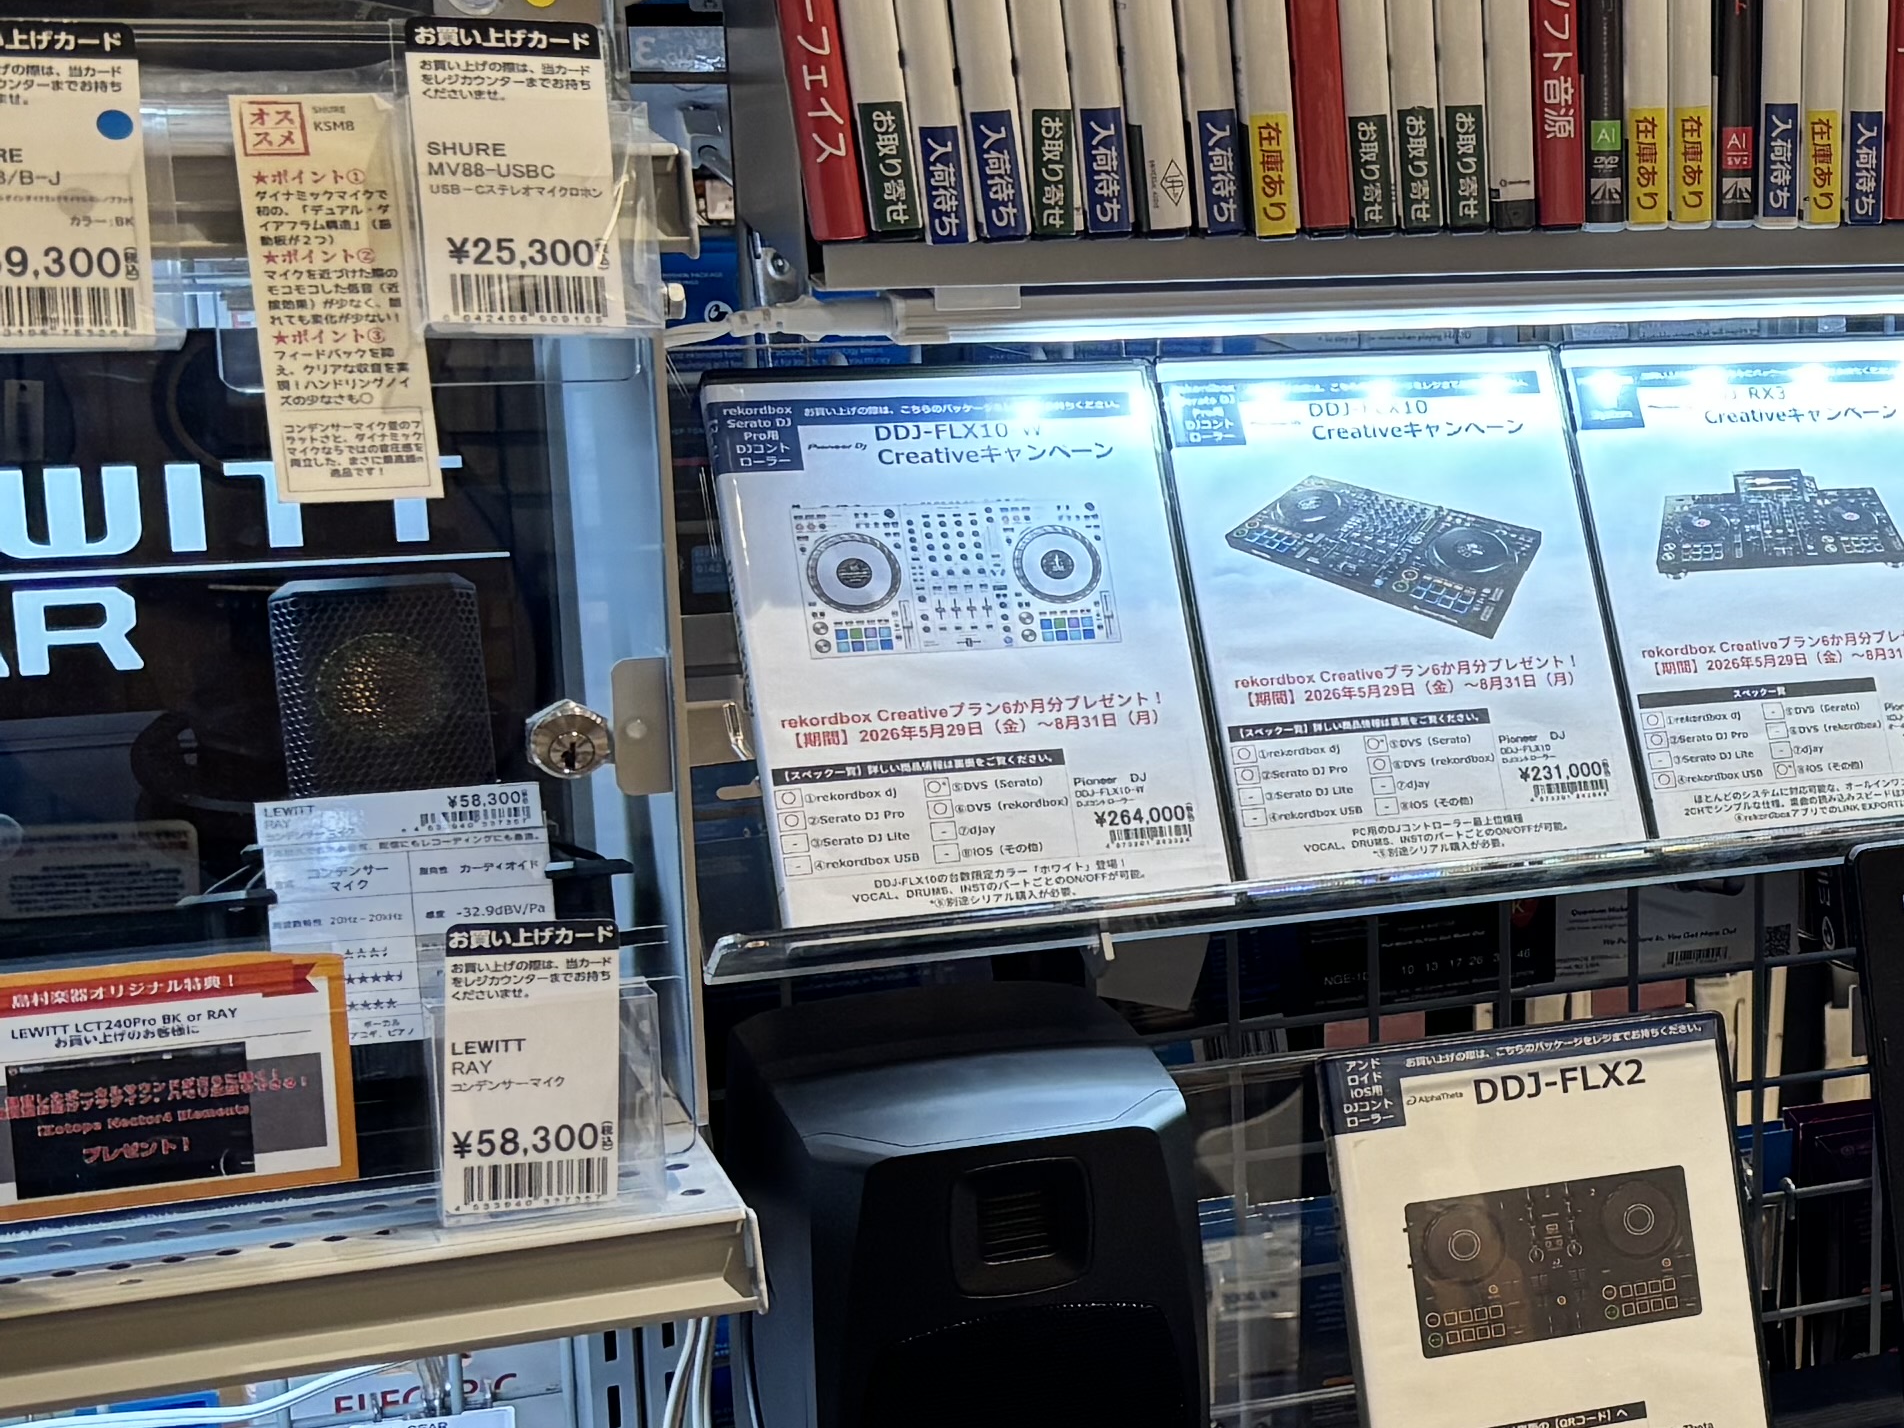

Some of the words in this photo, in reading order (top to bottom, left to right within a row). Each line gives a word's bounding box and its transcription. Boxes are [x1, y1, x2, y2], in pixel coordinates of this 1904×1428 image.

[414, 27, 590, 50] お買い上げカード
[426, 141, 506, 158] SHURE
[428, 162, 555, 180] MV88-USBC
[870, 111, 909, 224] お取り寄せ
[1258, 122, 1288, 221] 在庫あり
[255, 189, 387, 202] ダイナミックマイクで
[927, 138, 959, 236] 入荷待ち
[1704, 405, 1898, 426] Creativeキャンペーン
[877, 441, 1115, 466] Creativeキャンペーン
[1234, 673, 1315, 689] rekordbox
[780, 712, 871, 730] rekordbox
[1520, 762, 1602, 781] ¥231,000
[1094, 808, 1184, 828] ¥264,000
[448, 923, 614, 948] お買い上げカード
[451, 1038, 526, 1056] LEWITT
[451, 1060, 492, 1075] RAY
[451, 1075, 564, 1093] コンデンサーマイク
[1418, 1091, 1463, 1104] AlphaTheta
[1473, 1059, 1646, 1105] DDJ-FLX2
[451, 1123, 598, 1156] ¥58,300
